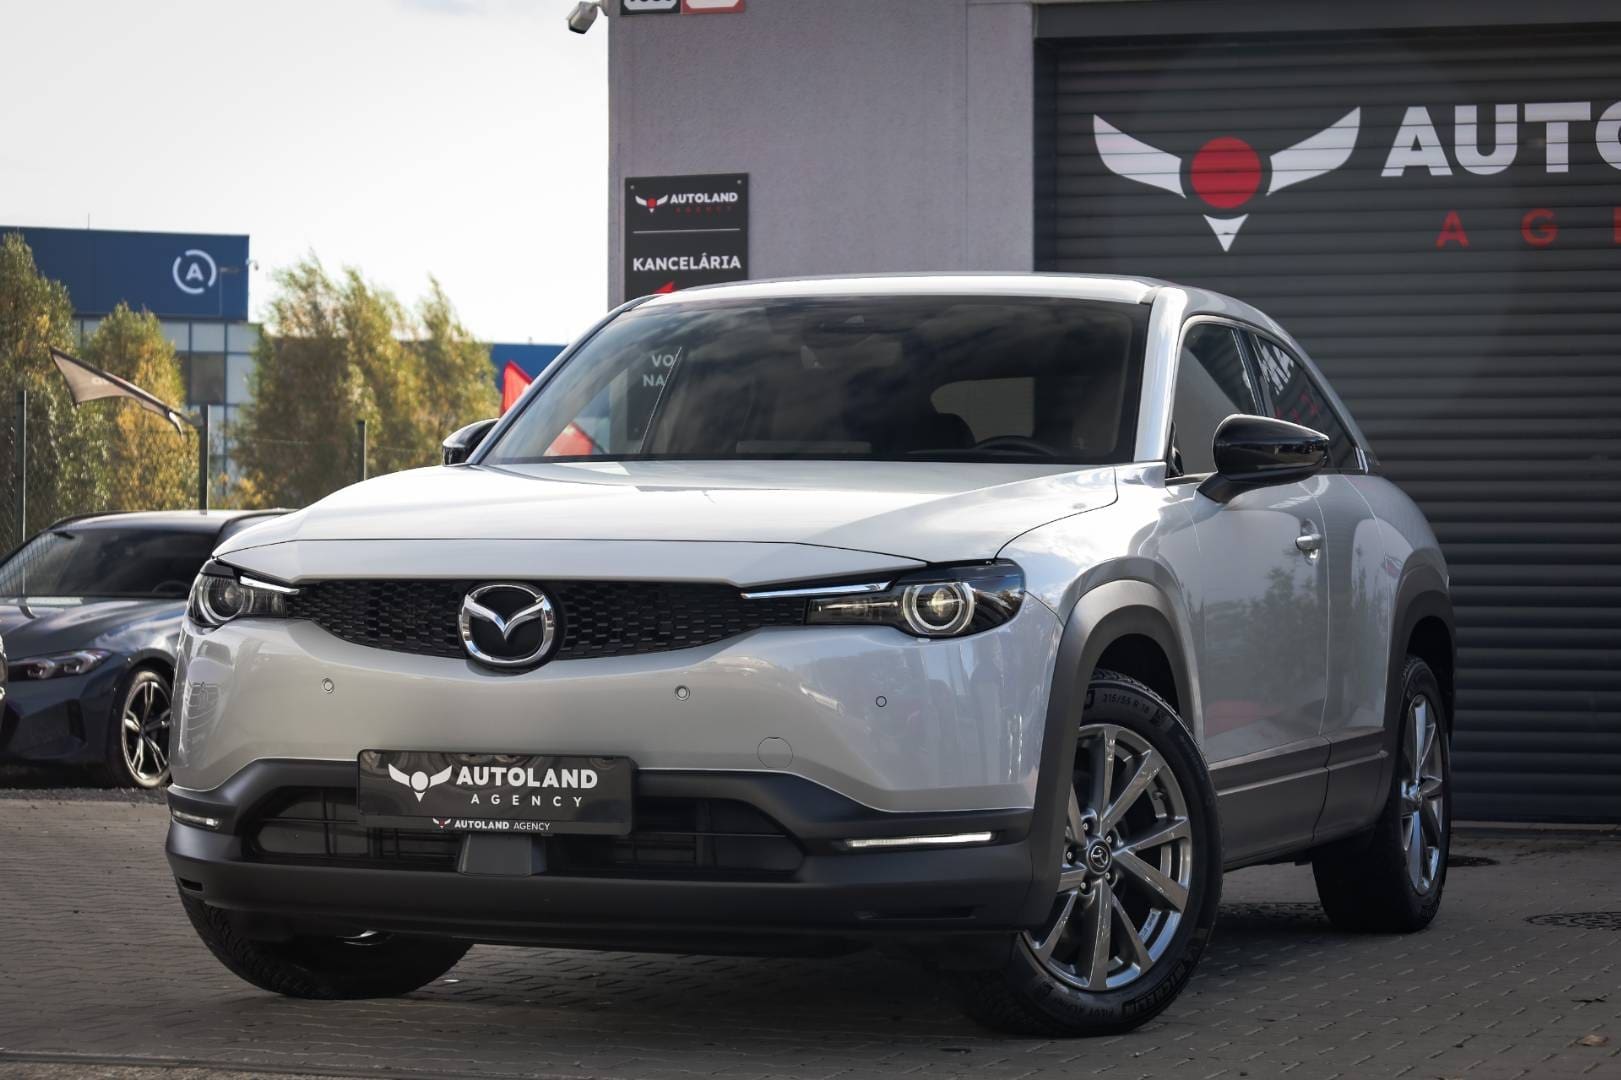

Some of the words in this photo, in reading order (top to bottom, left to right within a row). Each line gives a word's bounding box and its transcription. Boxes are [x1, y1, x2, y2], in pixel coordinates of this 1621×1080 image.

[669, 192, 738, 204] AUTOLAND
[1435, 208, 1621, 248] AG
[632, 252, 742, 271] KANCELÁRIA
[455, 765, 598, 789] AUTOLAND
[471, 793, 582, 808] AGENCY
[454, 819, 510, 830] AUTOLAND
[513, 821, 551, 831] AGENCY
